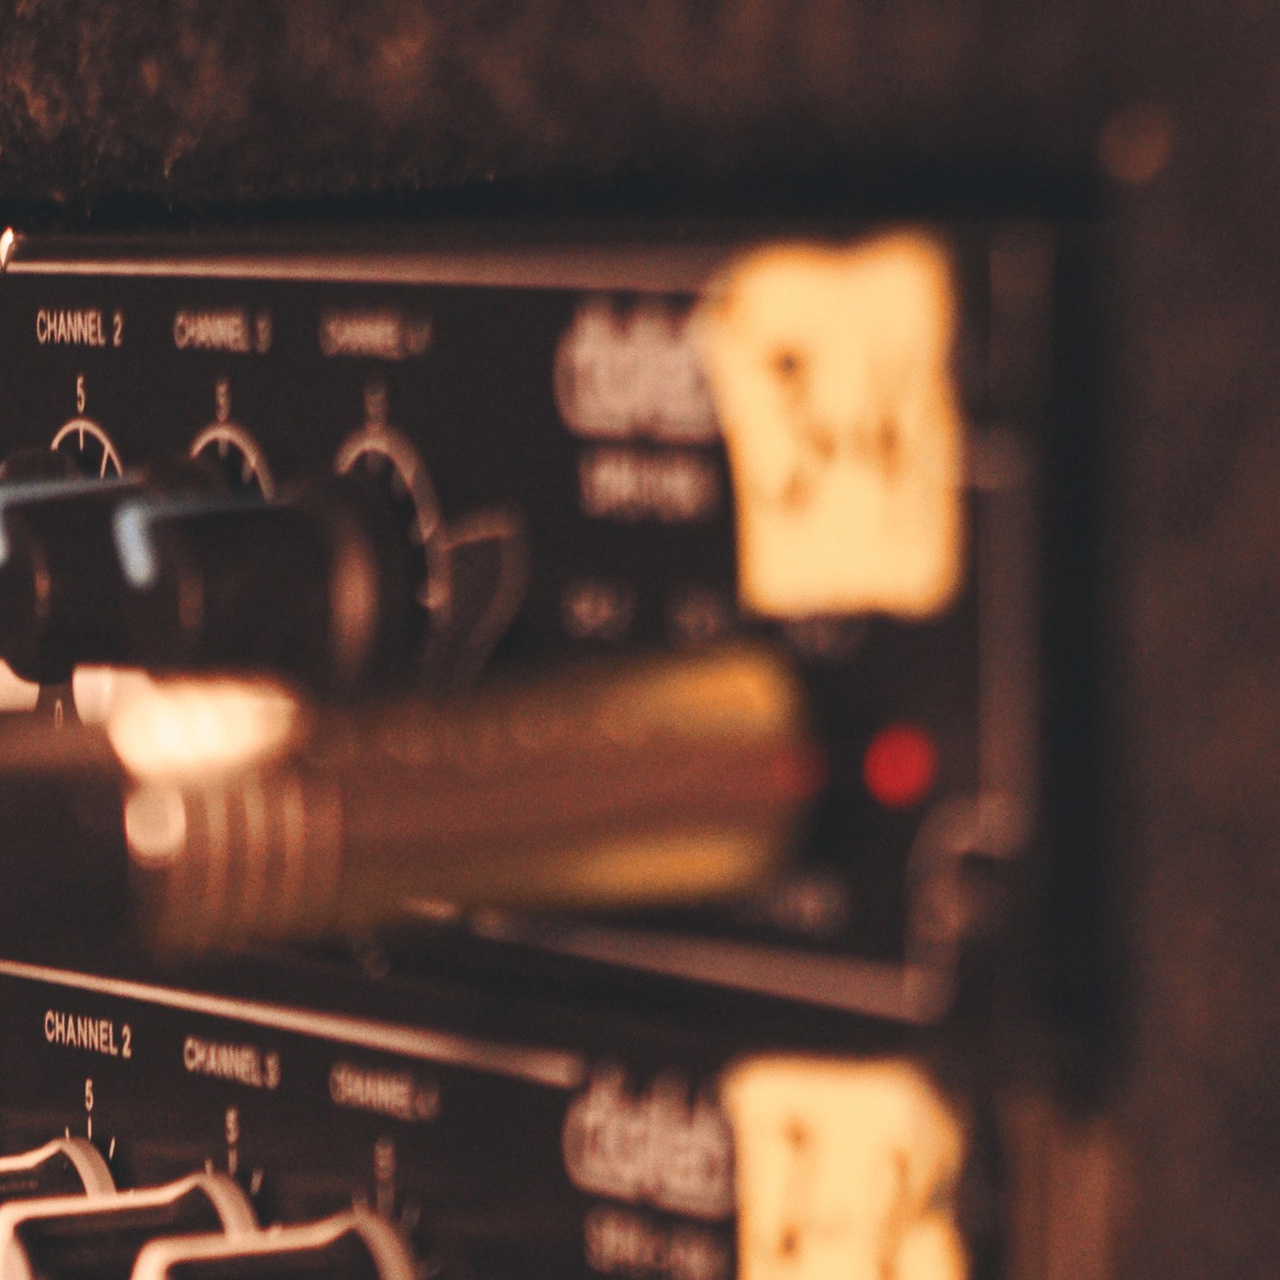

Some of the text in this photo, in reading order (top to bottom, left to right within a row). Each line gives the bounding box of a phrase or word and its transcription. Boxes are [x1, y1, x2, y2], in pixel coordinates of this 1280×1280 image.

[36, 308, 124, 346] CHANNEL 2
[75, 373, 86, 414] 5
[44, 1009, 132, 1059] CHANNEL 2
[84, 1076, 94, 1112] 5
